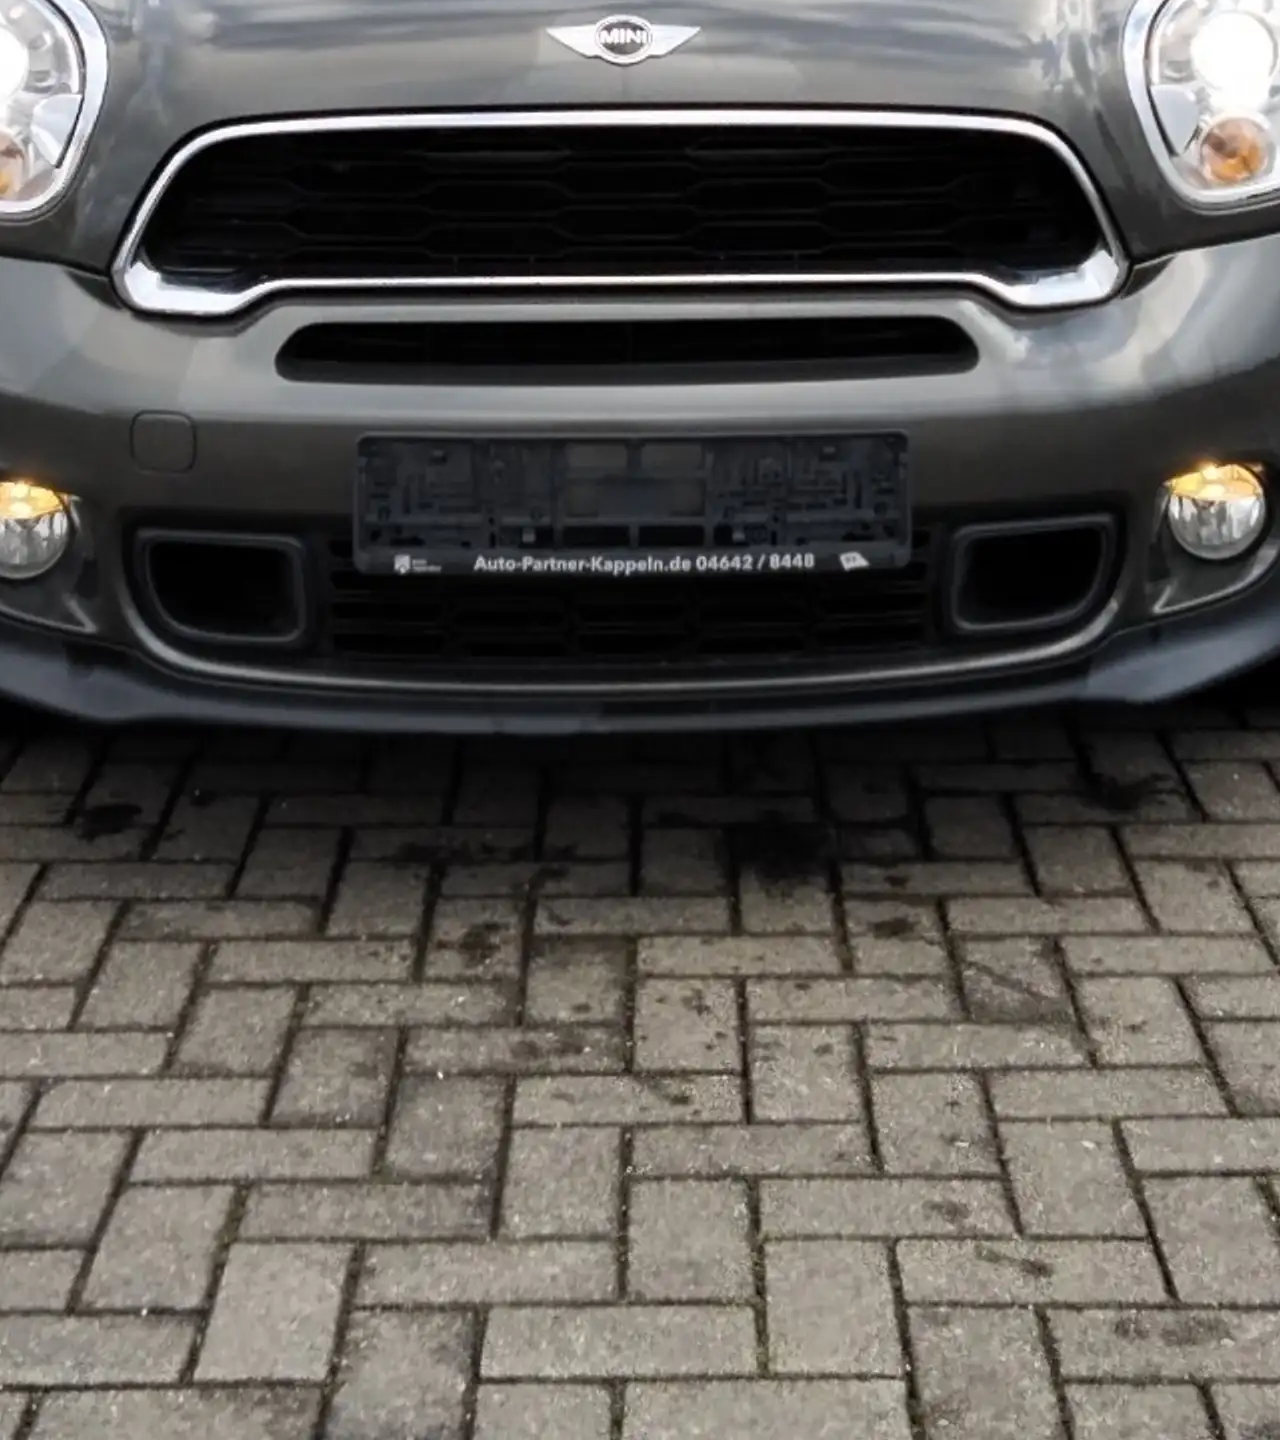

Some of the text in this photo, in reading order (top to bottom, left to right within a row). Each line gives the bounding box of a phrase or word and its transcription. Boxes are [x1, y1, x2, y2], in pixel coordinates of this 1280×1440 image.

[600, 28, 647, 44] MINI
[474, 555, 691, 576] Auto-Partner-Kappeln.de
[696, 554, 753, 571] 04642
